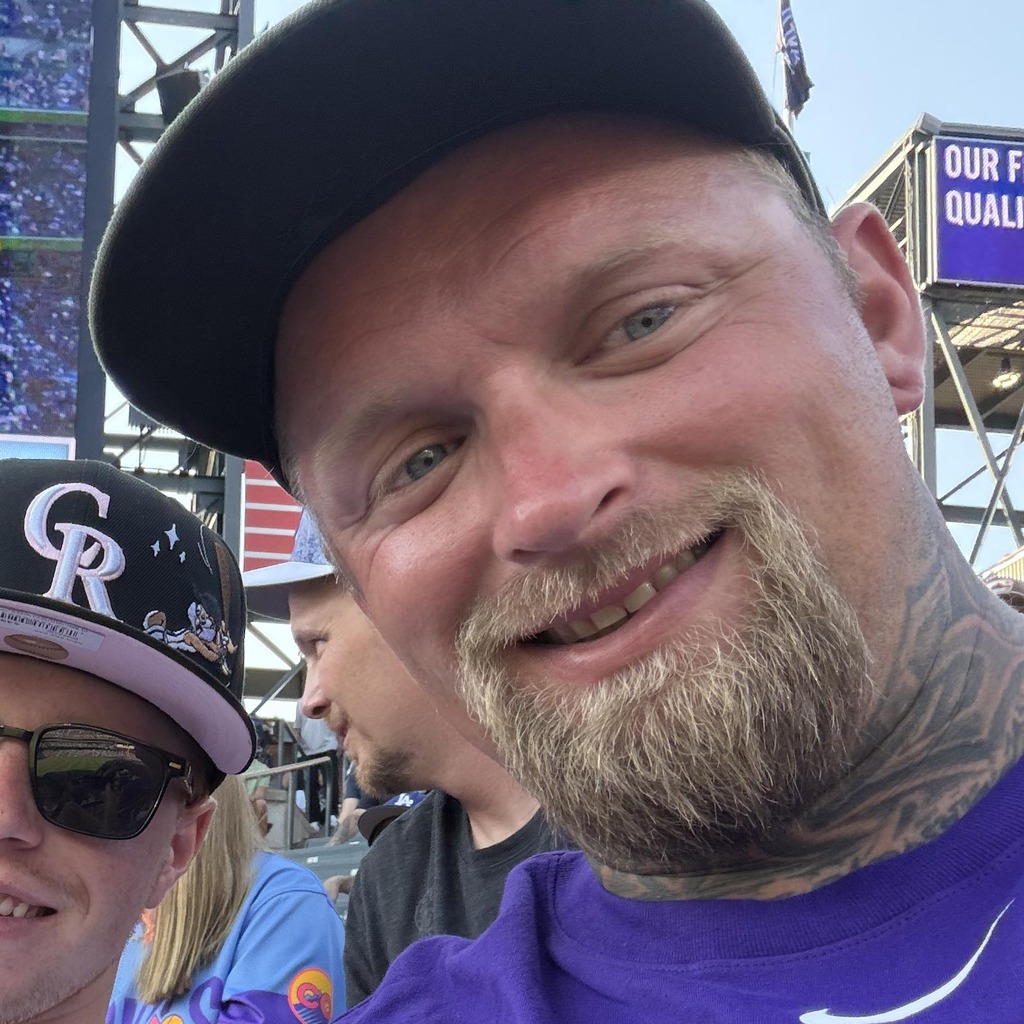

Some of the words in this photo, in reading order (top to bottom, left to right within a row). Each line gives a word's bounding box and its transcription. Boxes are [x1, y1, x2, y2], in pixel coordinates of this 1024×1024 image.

[944, 144, 1000, 182] OUR
[944, 189, 1024, 230] QUALI
[23, 482, 126, 623] CR
